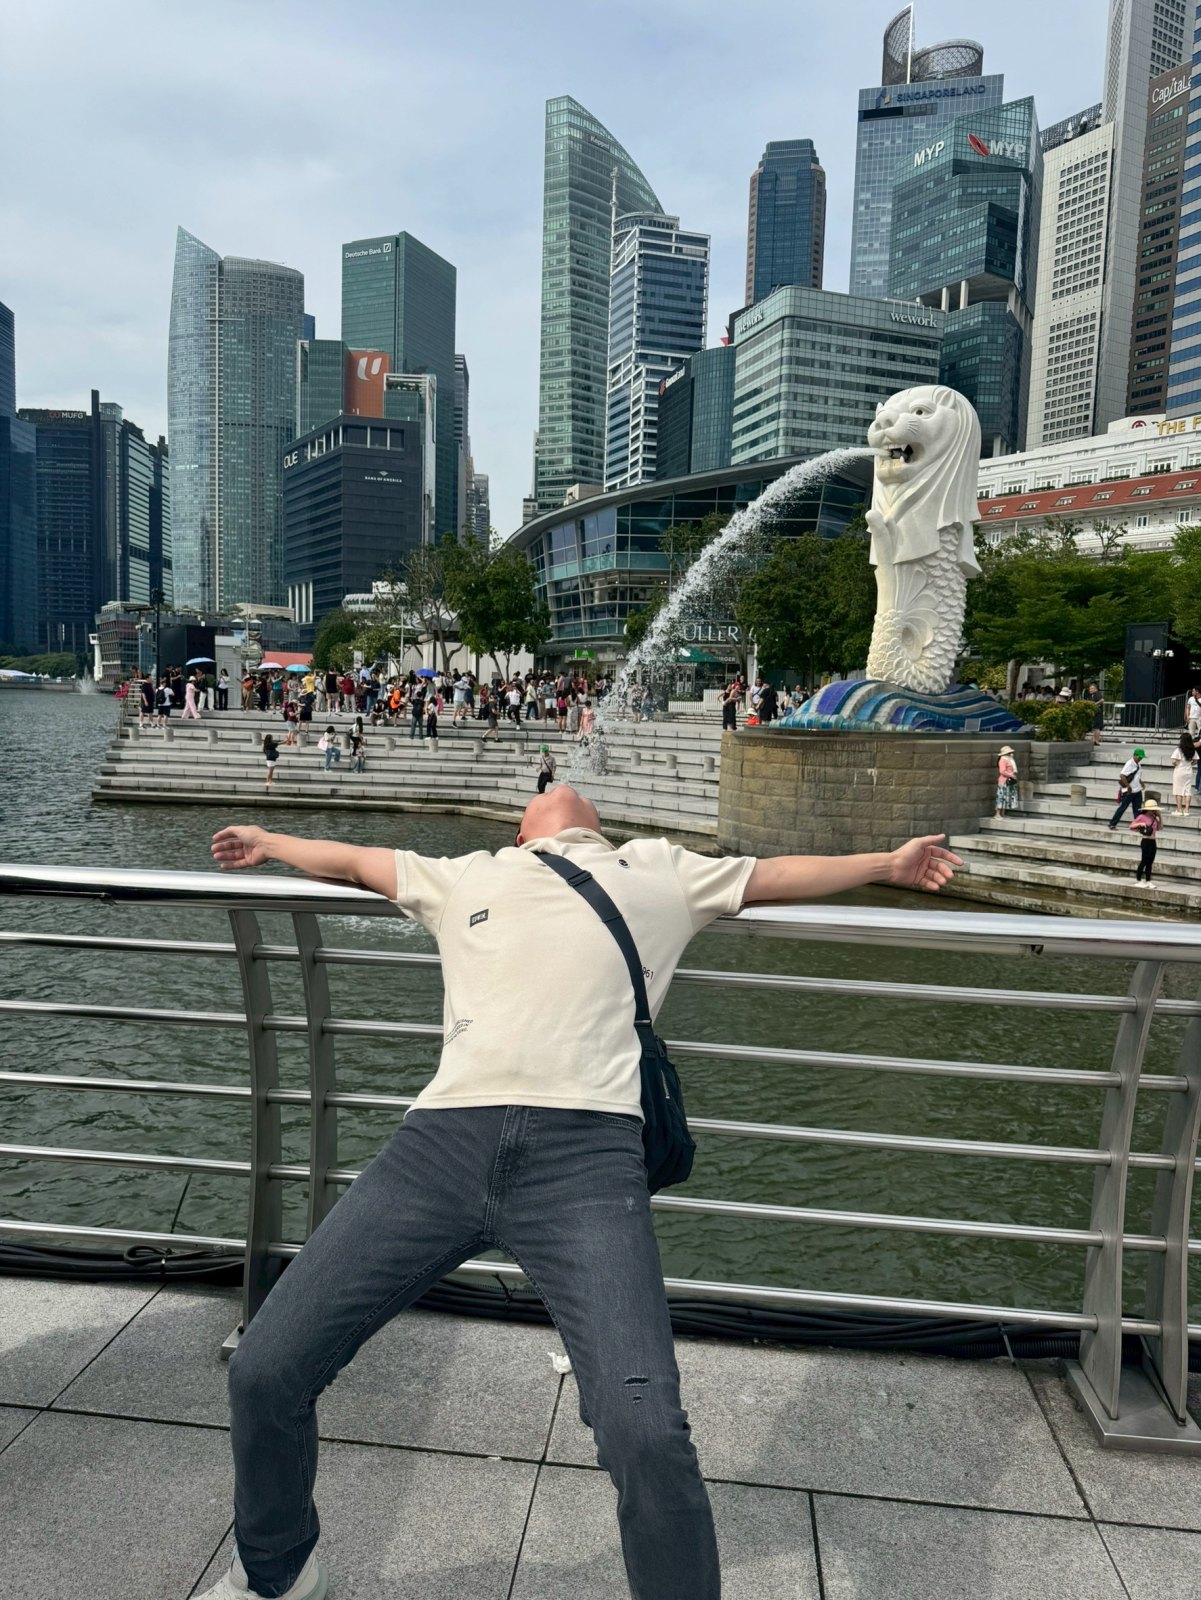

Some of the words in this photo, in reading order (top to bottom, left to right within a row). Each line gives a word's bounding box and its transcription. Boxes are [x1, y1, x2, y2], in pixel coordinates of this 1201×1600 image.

[896, 85, 986, 102] SINGAPORELAND
[914, 141, 945, 167] MYP
[990, 140, 1026, 157] MYP
[345, 250, 369, 259] Deutsche
[890, 311, 938, 328] wework
[61, 411, 84, 419] MUFG
[1157, 420, 1186, 435] THE
[283, 450, 299, 469] OUE
[642, 966, 654, 980] 961
